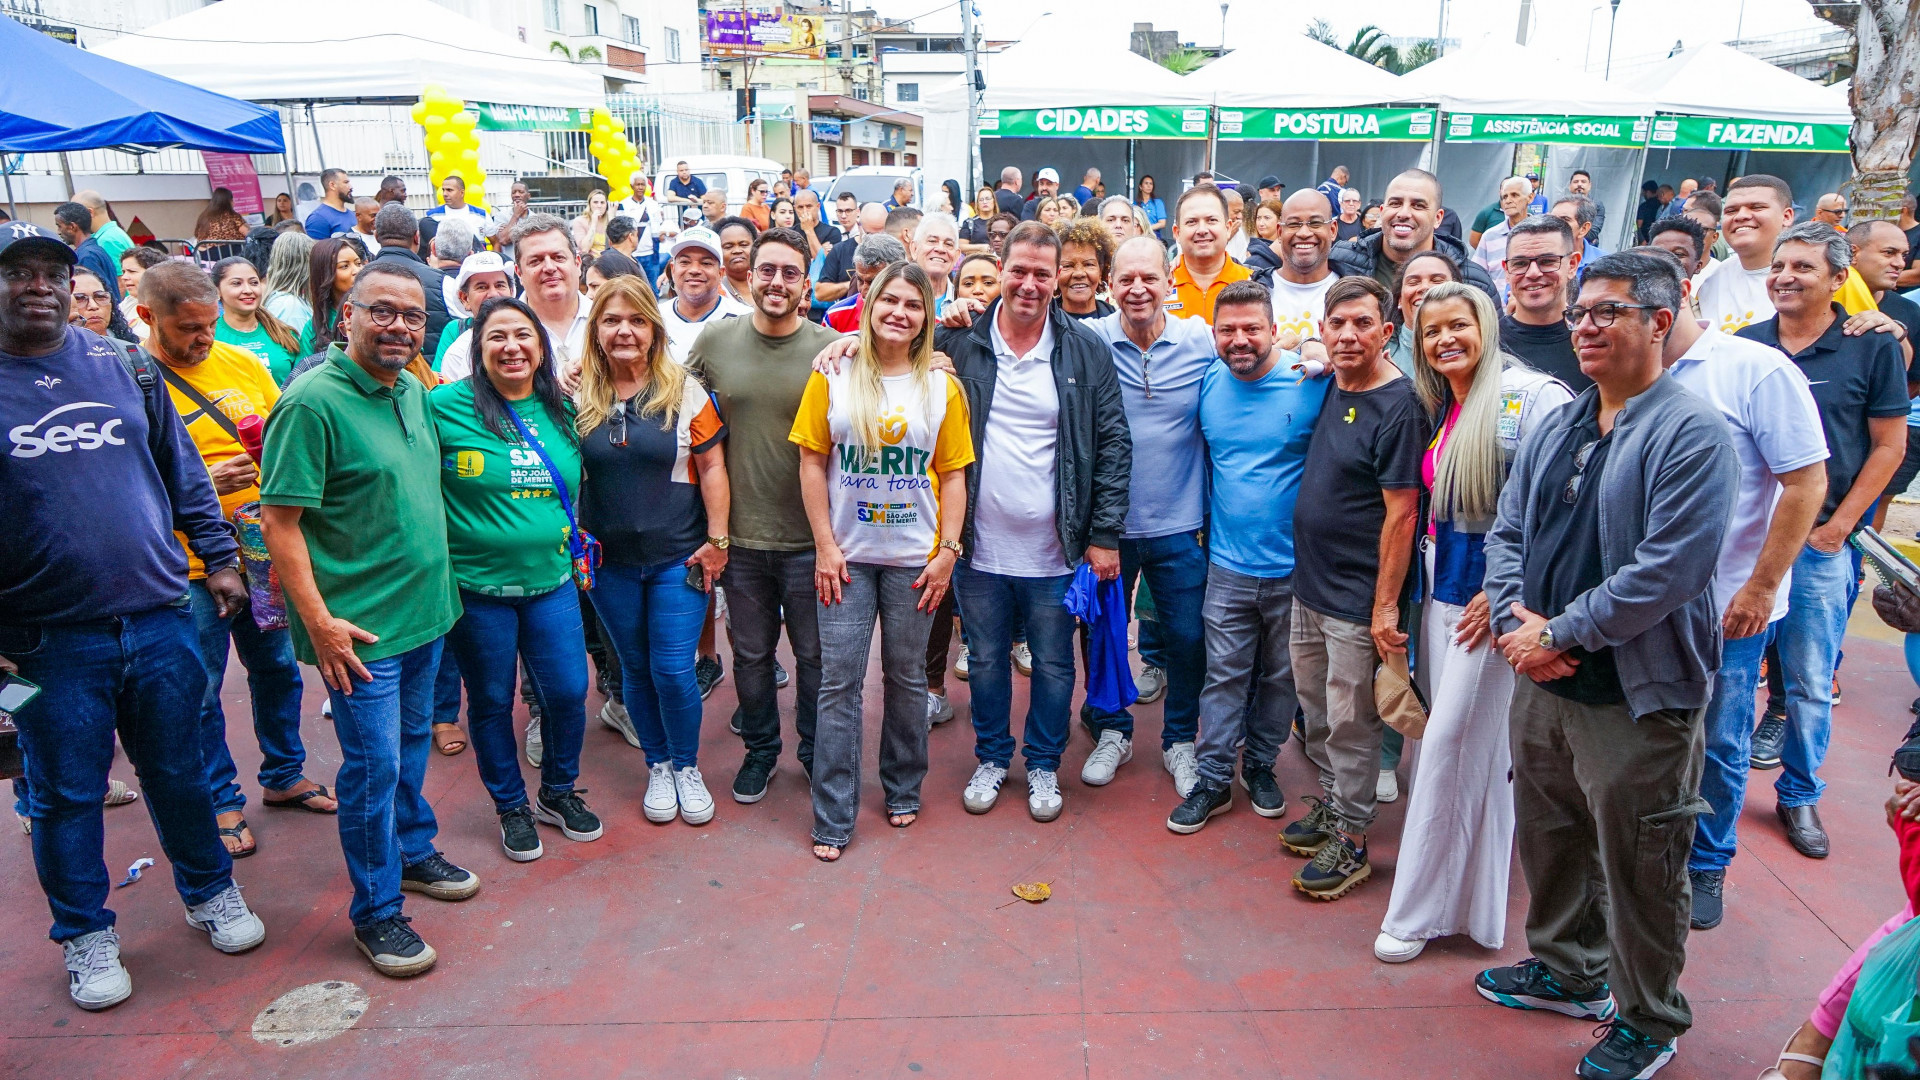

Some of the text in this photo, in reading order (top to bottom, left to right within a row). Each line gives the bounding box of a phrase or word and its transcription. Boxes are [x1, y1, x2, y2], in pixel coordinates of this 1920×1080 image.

[488, 103, 539, 121] MELHOR
[539, 106, 570, 122] IDADE
[1035, 109, 1149, 133] CIDADES
[1274, 113, 1380, 135] POSTURA
[1483, 118, 1570, 135] ASSISTÊNCIA
[1572, 122, 1621, 138] SOCIAL
[1707, 123, 1815, 146] FAZENDA
[837, 442, 931, 476] MERIT
[510, 468, 551, 477] SÃO JOÃO
[887, 472, 931, 492] todo
[857, 508, 886, 524] SJM
[900, 511, 917, 519] JOÃO
